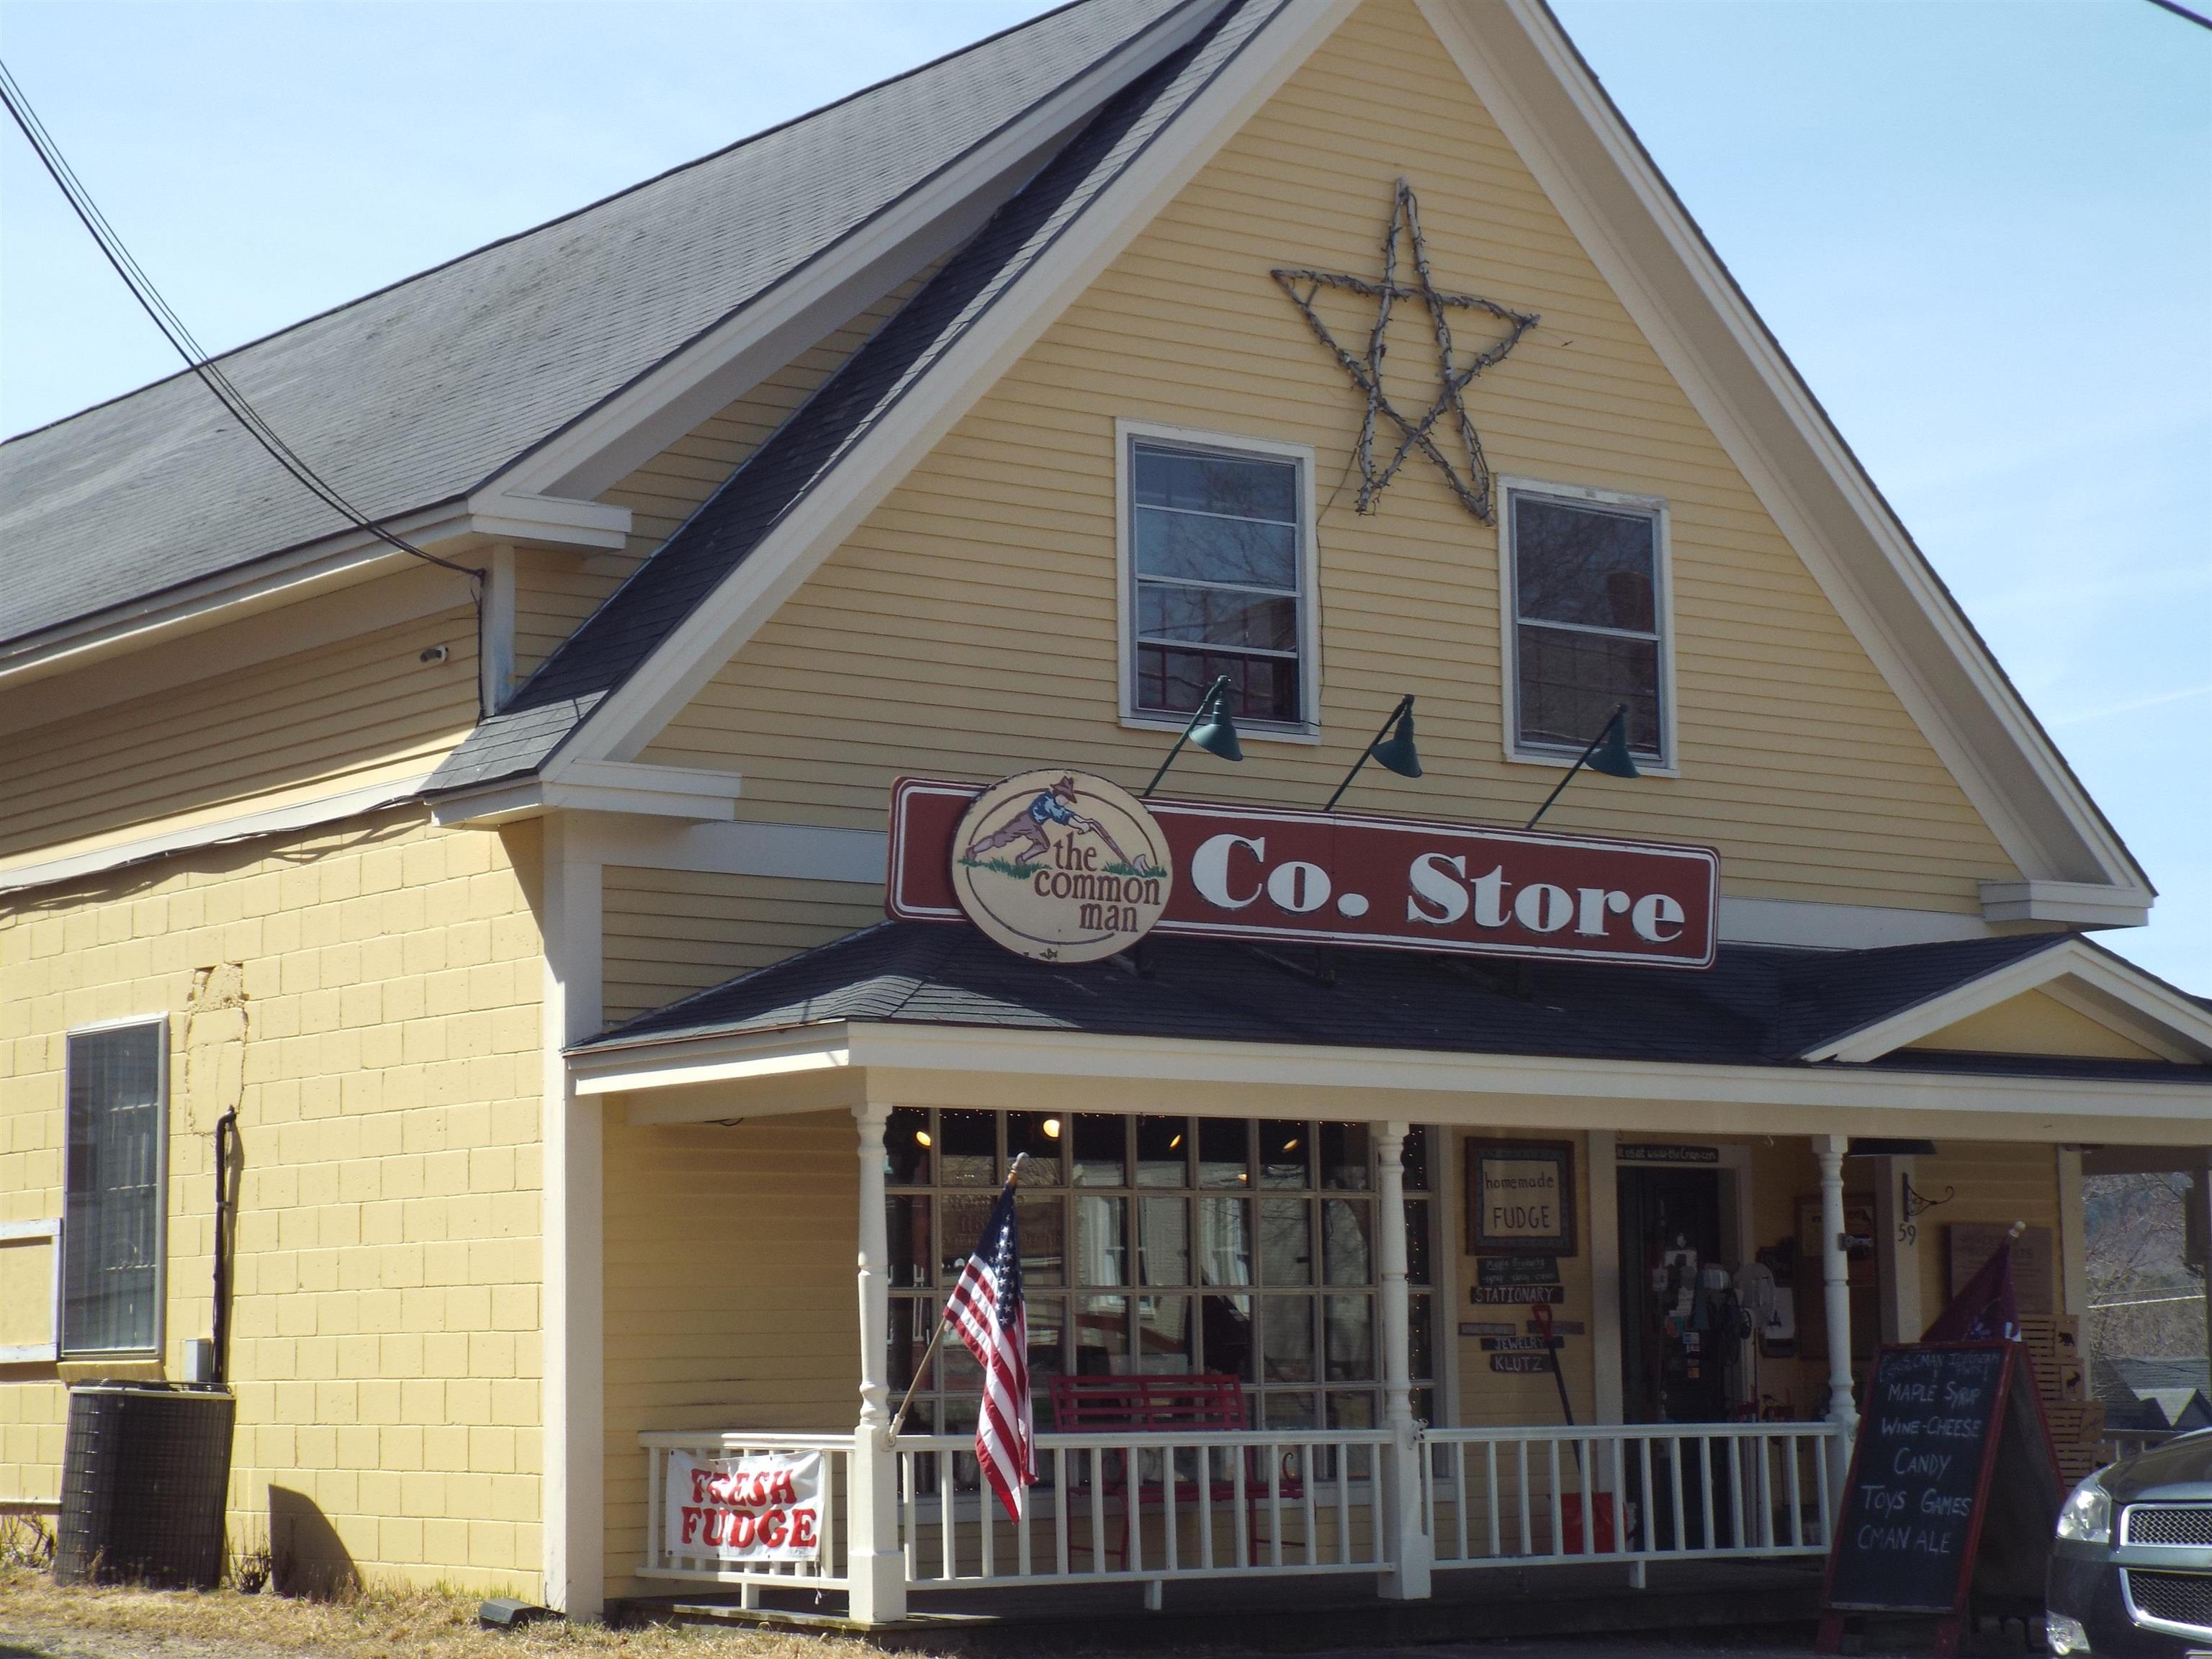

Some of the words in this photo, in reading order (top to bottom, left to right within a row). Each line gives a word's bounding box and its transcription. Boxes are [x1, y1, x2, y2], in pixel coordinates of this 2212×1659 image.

[1053, 837, 1097, 873] the
[1033, 871, 1161, 908] common
[1190, 833, 1369, 918] Co.
[1406, 852, 1686, 944] Store
[1079, 902, 1138, 934] man
[1485, 1172, 1555, 1190] homemade
[1493, 1205, 1550, 1228] FUDGE
[1897, 1225, 1916, 1246] 59
[1475, 1287, 1555, 1303] STATIONARY
[1495, 1336, 1545, 1349] JEWELRY
[1495, 1356, 1543, 1372] KLUTZ
[1887, 1382, 1938, 1403] MAPLE
[1893, 1447, 1953, 1481] CANDY
[691, 1468, 798, 1507] FRESH
[1860, 1485, 1907, 1519] TOYS
[1920, 1488, 1972, 1517] GAMES
[680, 1506, 818, 1548] FUDGE
[1858, 1524, 1910, 1550] CMAN
[1915, 1529, 1951, 1555] ALE
